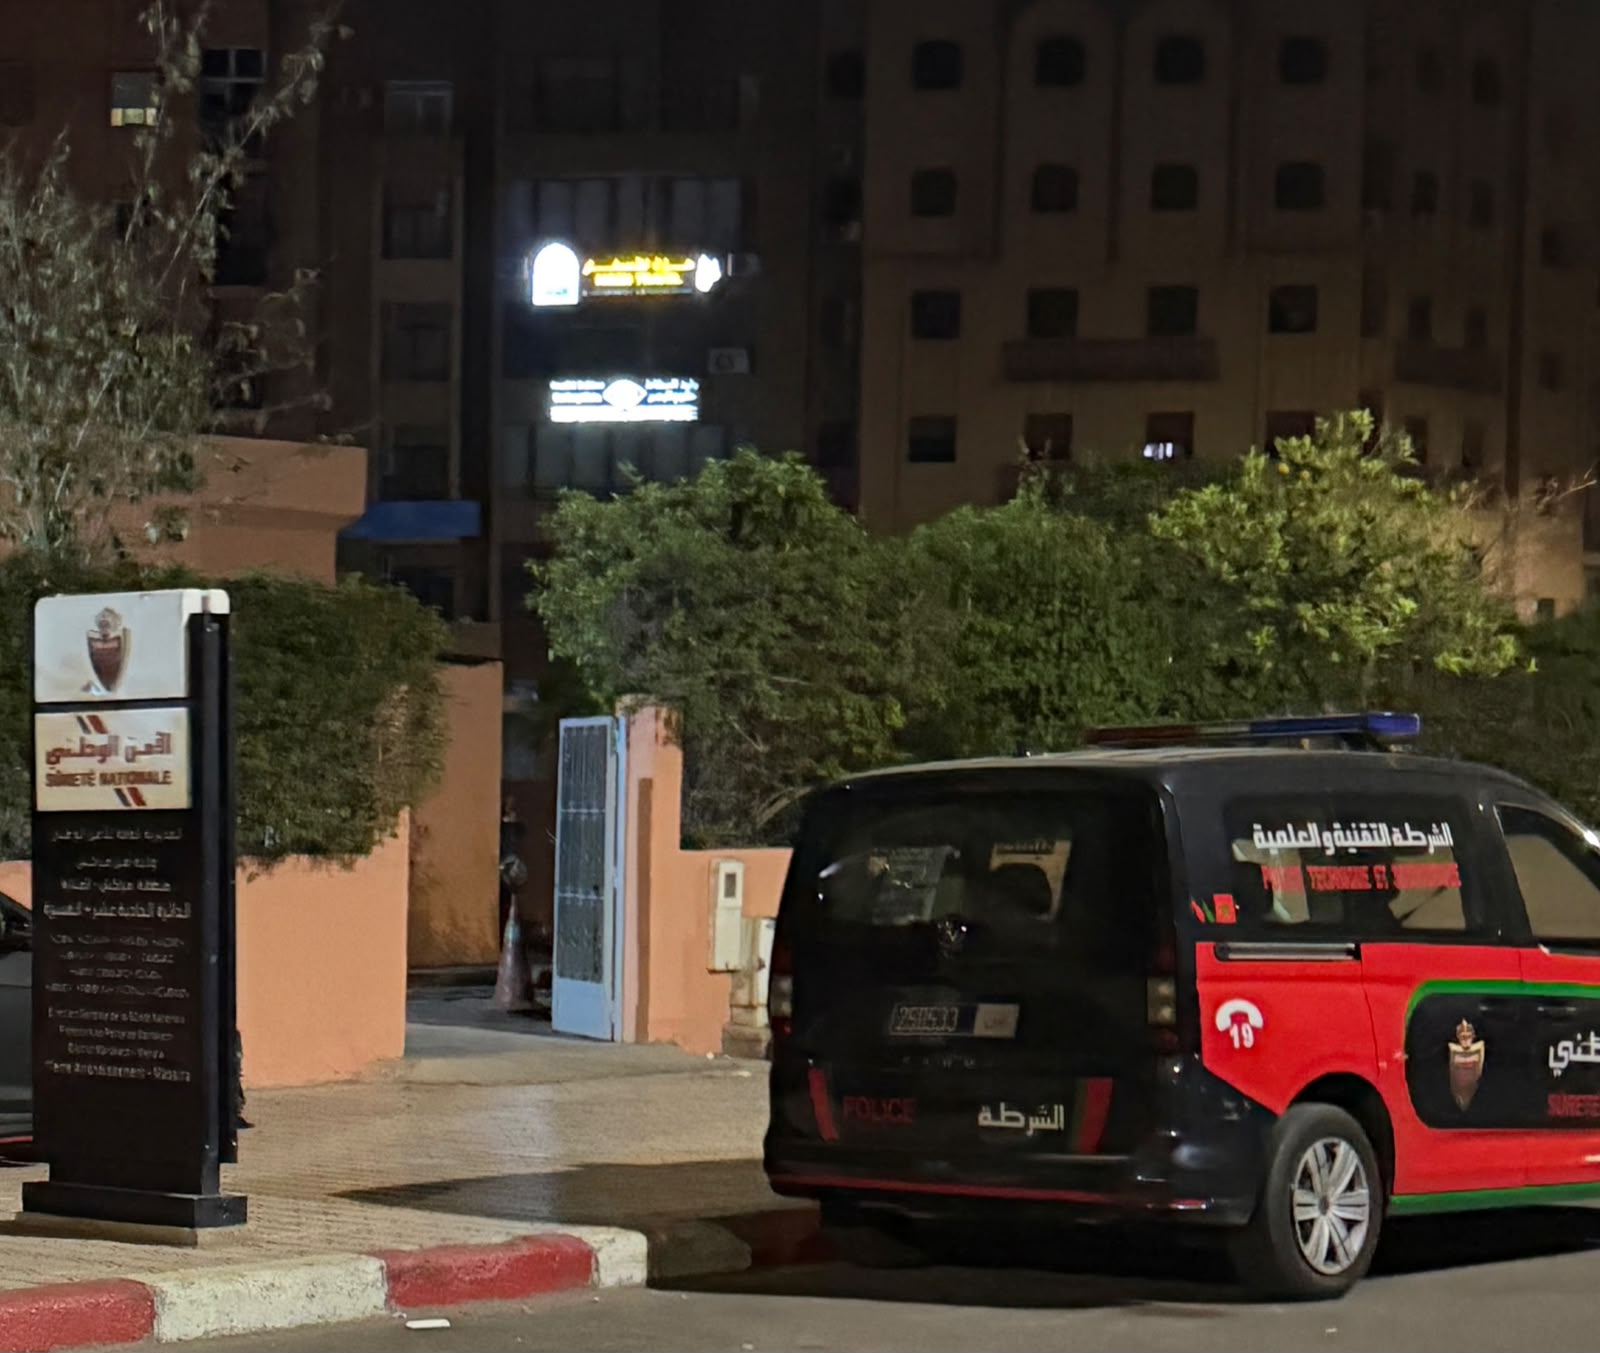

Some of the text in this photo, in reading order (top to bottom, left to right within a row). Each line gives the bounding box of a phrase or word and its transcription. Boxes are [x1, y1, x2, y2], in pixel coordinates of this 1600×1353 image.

[1391, 822, 1454, 855] الشرطة
[1229, 1022, 1254, 1049] 19
[842, 1095, 915, 1123] POLICE
[977, 1102, 1065, 1136] الشرطة
